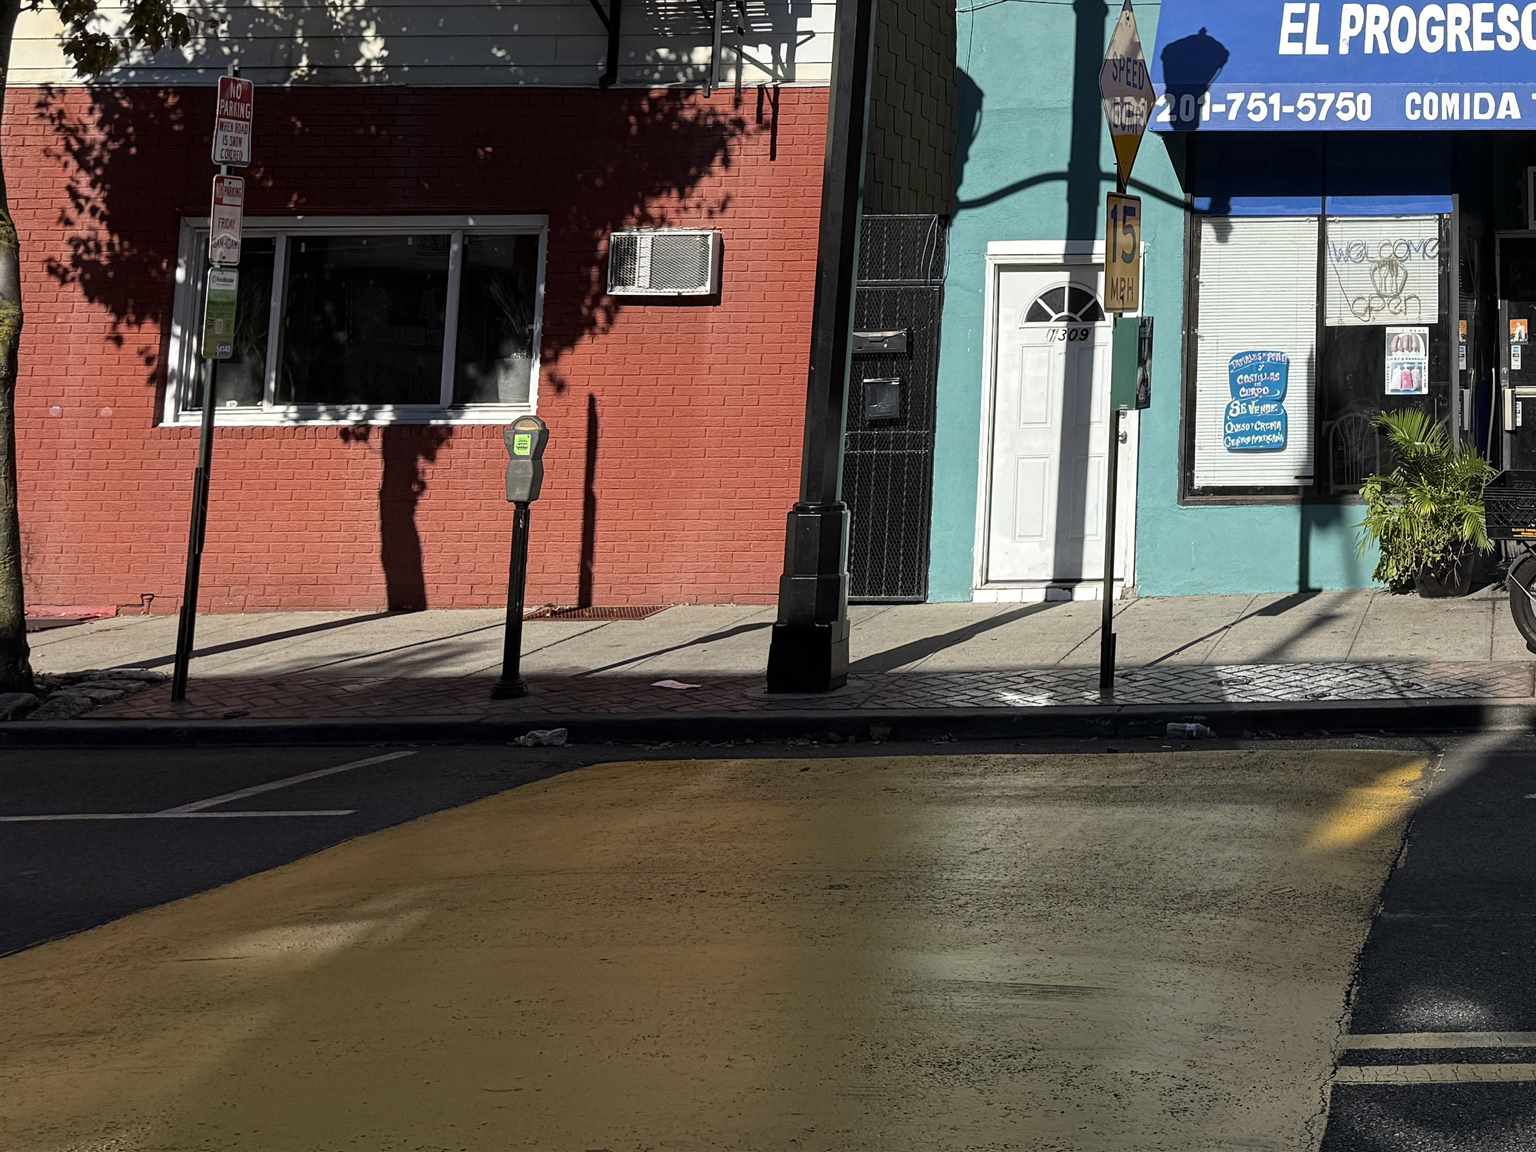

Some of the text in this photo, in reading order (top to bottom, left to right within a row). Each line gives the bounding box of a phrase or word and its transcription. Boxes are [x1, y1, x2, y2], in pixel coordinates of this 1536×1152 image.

[1278, 1, 1330, 56] EL
[1111, 51, 1145, 90] SPEED
[229, 82, 243, 100] NO
[219, 98, 251, 119] PARKING
[1155, 91, 1373, 122] 201-751-5750
[1404, 91, 1521, 121] COMIDA
[1109, 203, 1136, 264] 15
[1110, 276, 1135, 301] MPH
[1046, 327, 1091, 342] 1309
